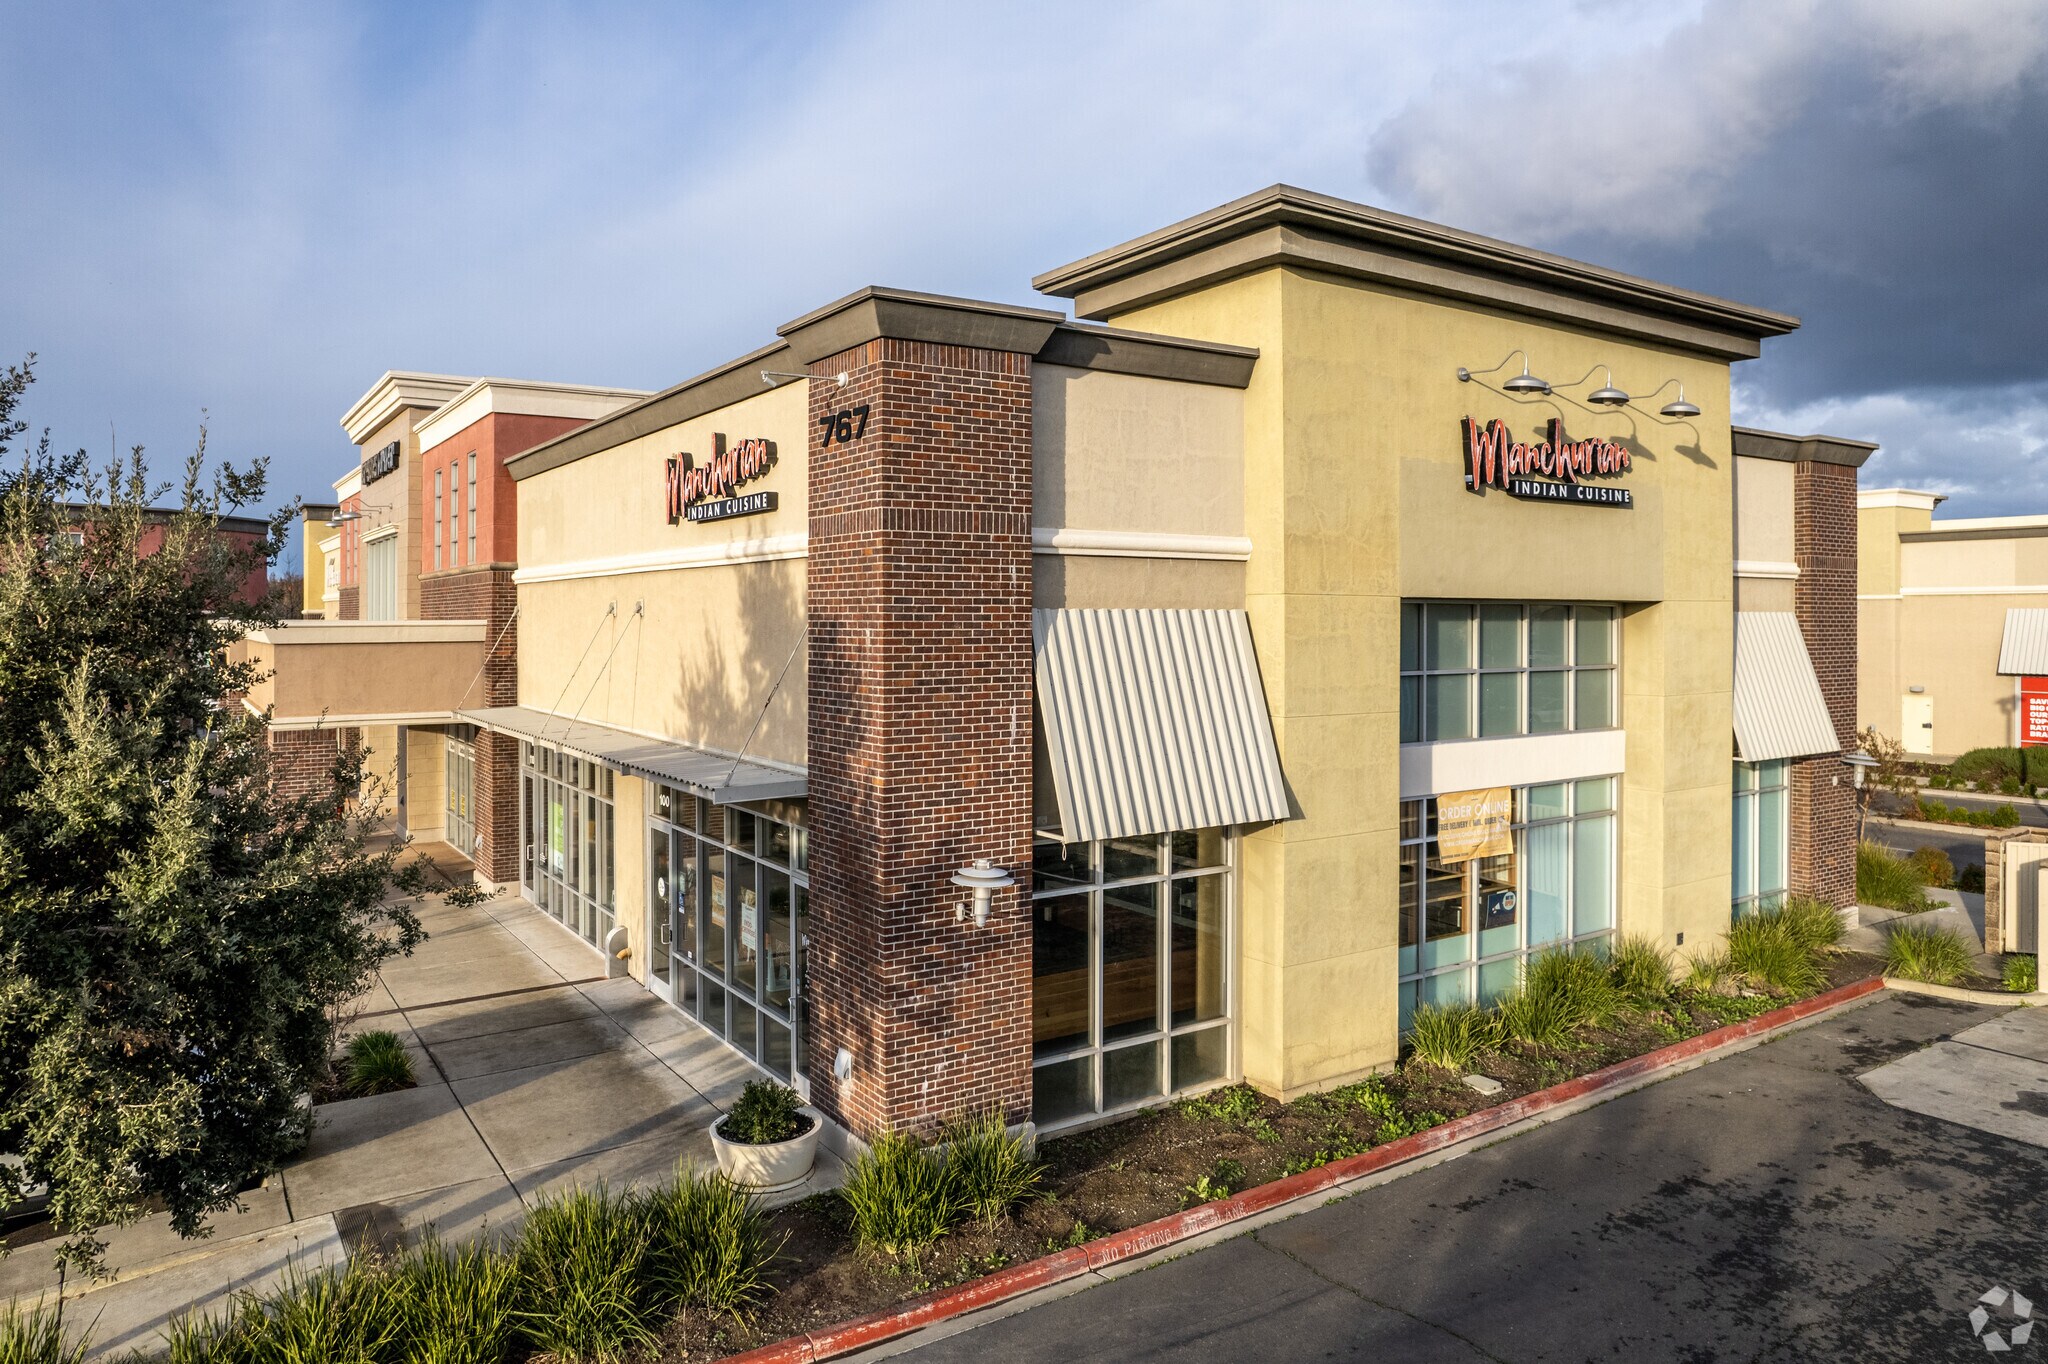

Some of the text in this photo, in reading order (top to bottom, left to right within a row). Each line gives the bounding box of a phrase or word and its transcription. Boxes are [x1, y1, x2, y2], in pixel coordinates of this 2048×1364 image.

[819, 404, 870, 448] 767
[1468, 417, 1630, 491] Manchurian
[664, 431, 768, 526] Manchurian
[1515, 480, 1630, 503] INDIAN CUISINE
[687, 493, 768, 521] INDIAN CUISINE
[660, 794, 670, 807] 100
[1439, 800, 1509, 820] ORDER ONLINE
[1101, 1246, 1119, 1263] NO
[1123, 1228, 1173, 1257] PARKING
